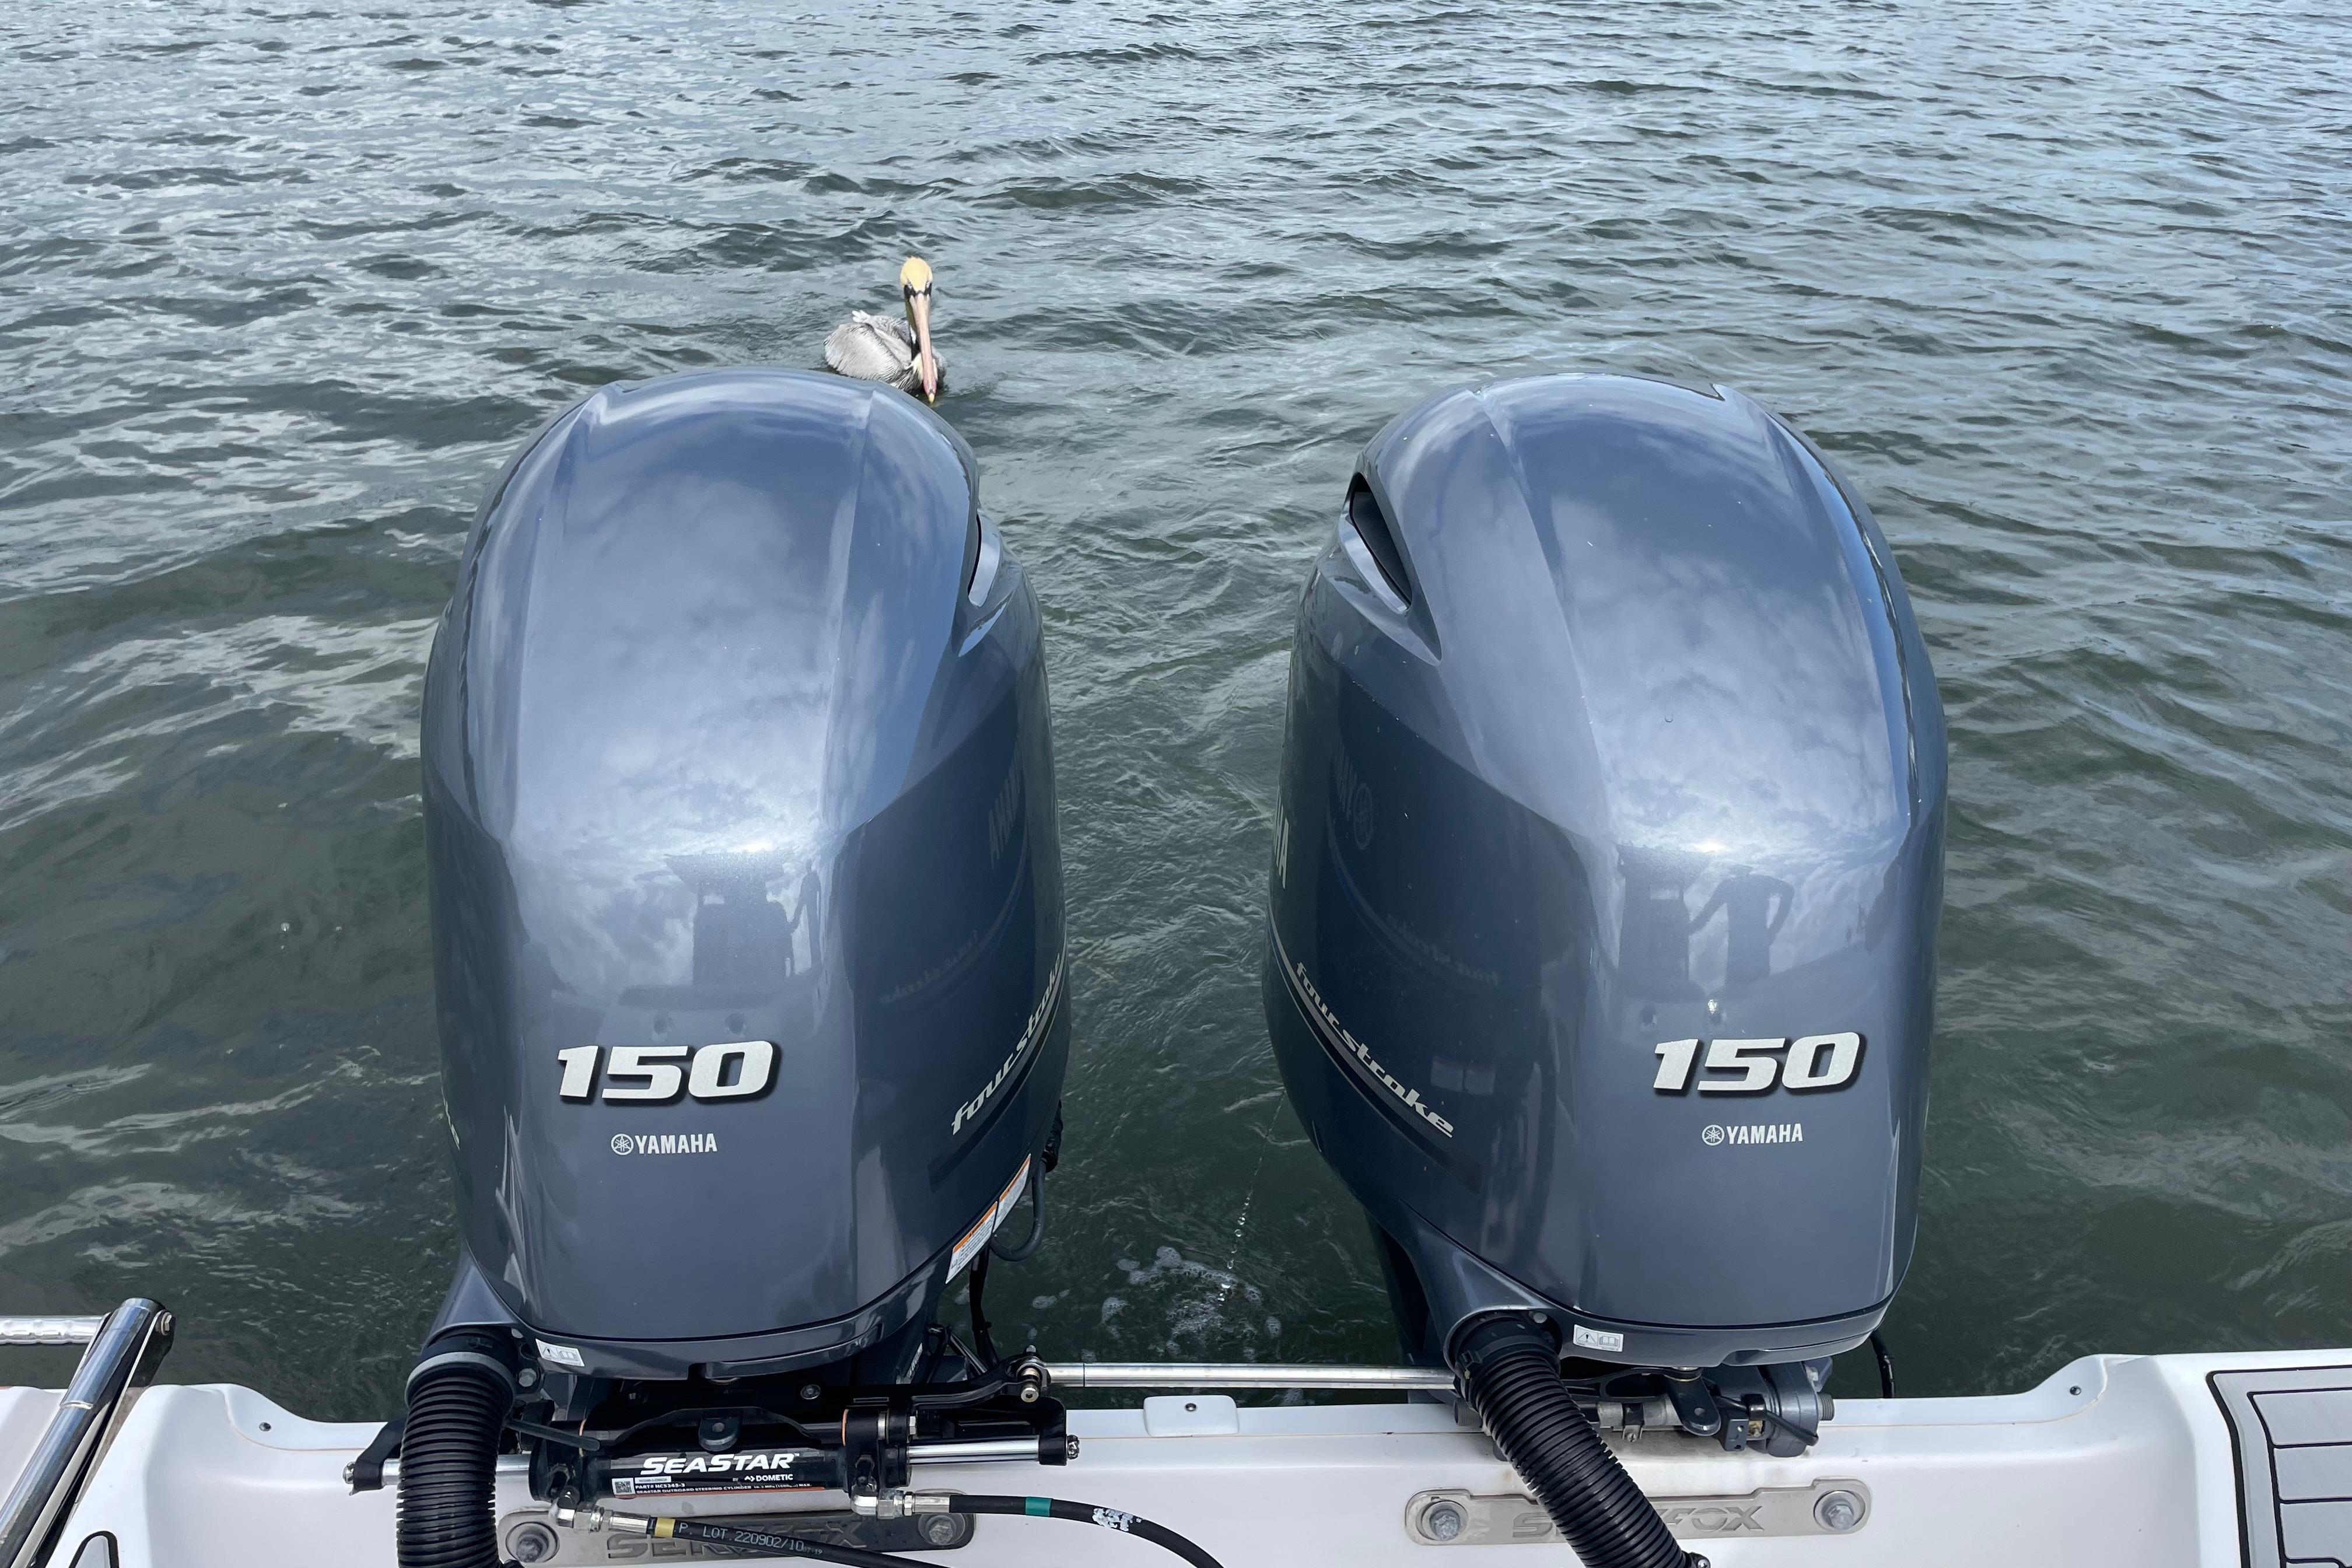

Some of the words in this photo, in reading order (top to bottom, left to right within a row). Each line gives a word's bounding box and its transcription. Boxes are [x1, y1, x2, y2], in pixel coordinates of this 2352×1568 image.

[557, 1041, 774, 1098] 150
[1653, 1032, 1860, 1090] 150
[635, 1133, 718, 1154] YAMAHA
[1727, 1124, 1803, 1144] YAMAHA
